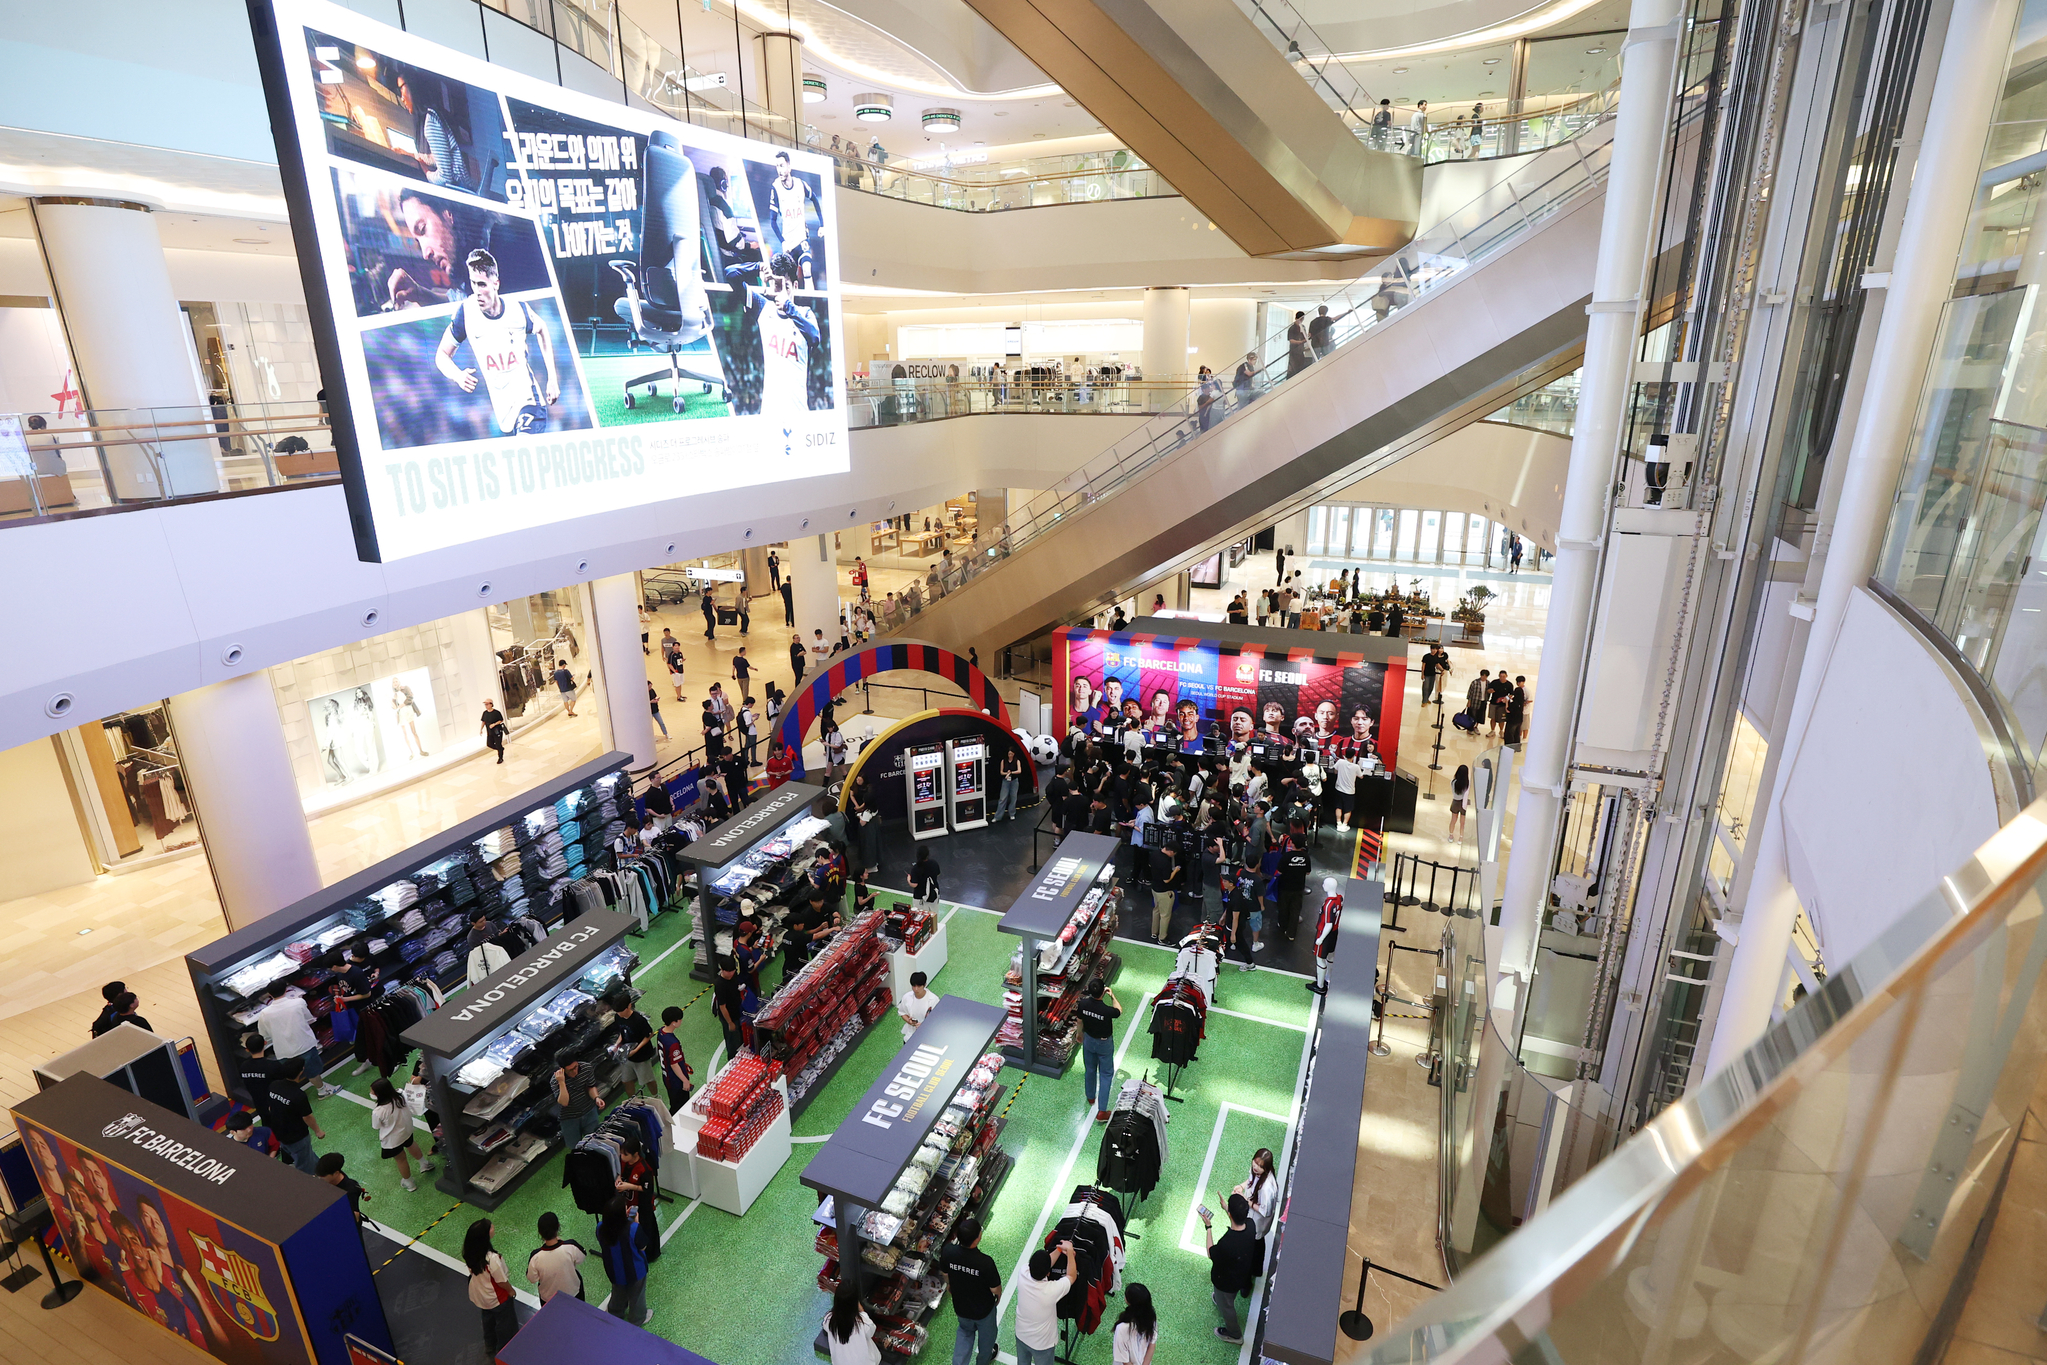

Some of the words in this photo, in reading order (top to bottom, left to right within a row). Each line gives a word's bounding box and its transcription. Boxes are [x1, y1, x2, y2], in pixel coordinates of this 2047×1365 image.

[502, 131, 586, 170] 그라운드와
[587, 136, 620, 170] 의자
[620, 136, 638, 170] 위
[505, 178, 558, 214] 우리의
[557, 178, 606, 214] 목표는
[551, 220, 616, 258] 나아가는
[615, 218, 634, 252] 것
[769, 335, 799, 362] AIA
[486, 352, 519, 370] AIA
[908, 364, 946, 378] RECLOW
[806, 432, 836, 447] SIDIZ
[386, 460, 426, 516] TO
[428, 456, 470, 510] SIT
[473, 452, 500, 501] IS
[502, 447, 536, 496] TO
[536, 434, 646, 490] PROGRESS
[1124, 657, 1136, 667] FC
[1138, 658, 1203, 674] BARCELONA
[1188, 682, 1205, 690] SEOUL
[1224, 686, 1256, 695] BARCELONA
[1259, 669, 1272, 682] FC
[1274, 670, 1309, 686] SEOUL
[778, 792, 799, 802] FC
[710, 801, 786, 847] BARCELONA
[1042, 857, 1082, 887] SEOUL
[1032, 886, 1060, 901] FC
[570, 925, 600, 943] FC
[450, 941, 577, 1021] BARCELONA
[1082, 1010, 1104, 1020] REFEREE
[862, 1098, 904, 1130] FC
[884, 1043, 948, 1101] SEOUL
[902, 1093, 931, 1122] FOOTBALL
[924, 1076, 941, 1093] CLUB
[935, 1059, 955, 1077] SEOUL
[124, 1126, 156, 1144] FC
[142, 1134, 236, 1185] BARCELONA
[950, 1262, 980, 1276] REFEREE
[222, 1278, 252, 1301] FCB
